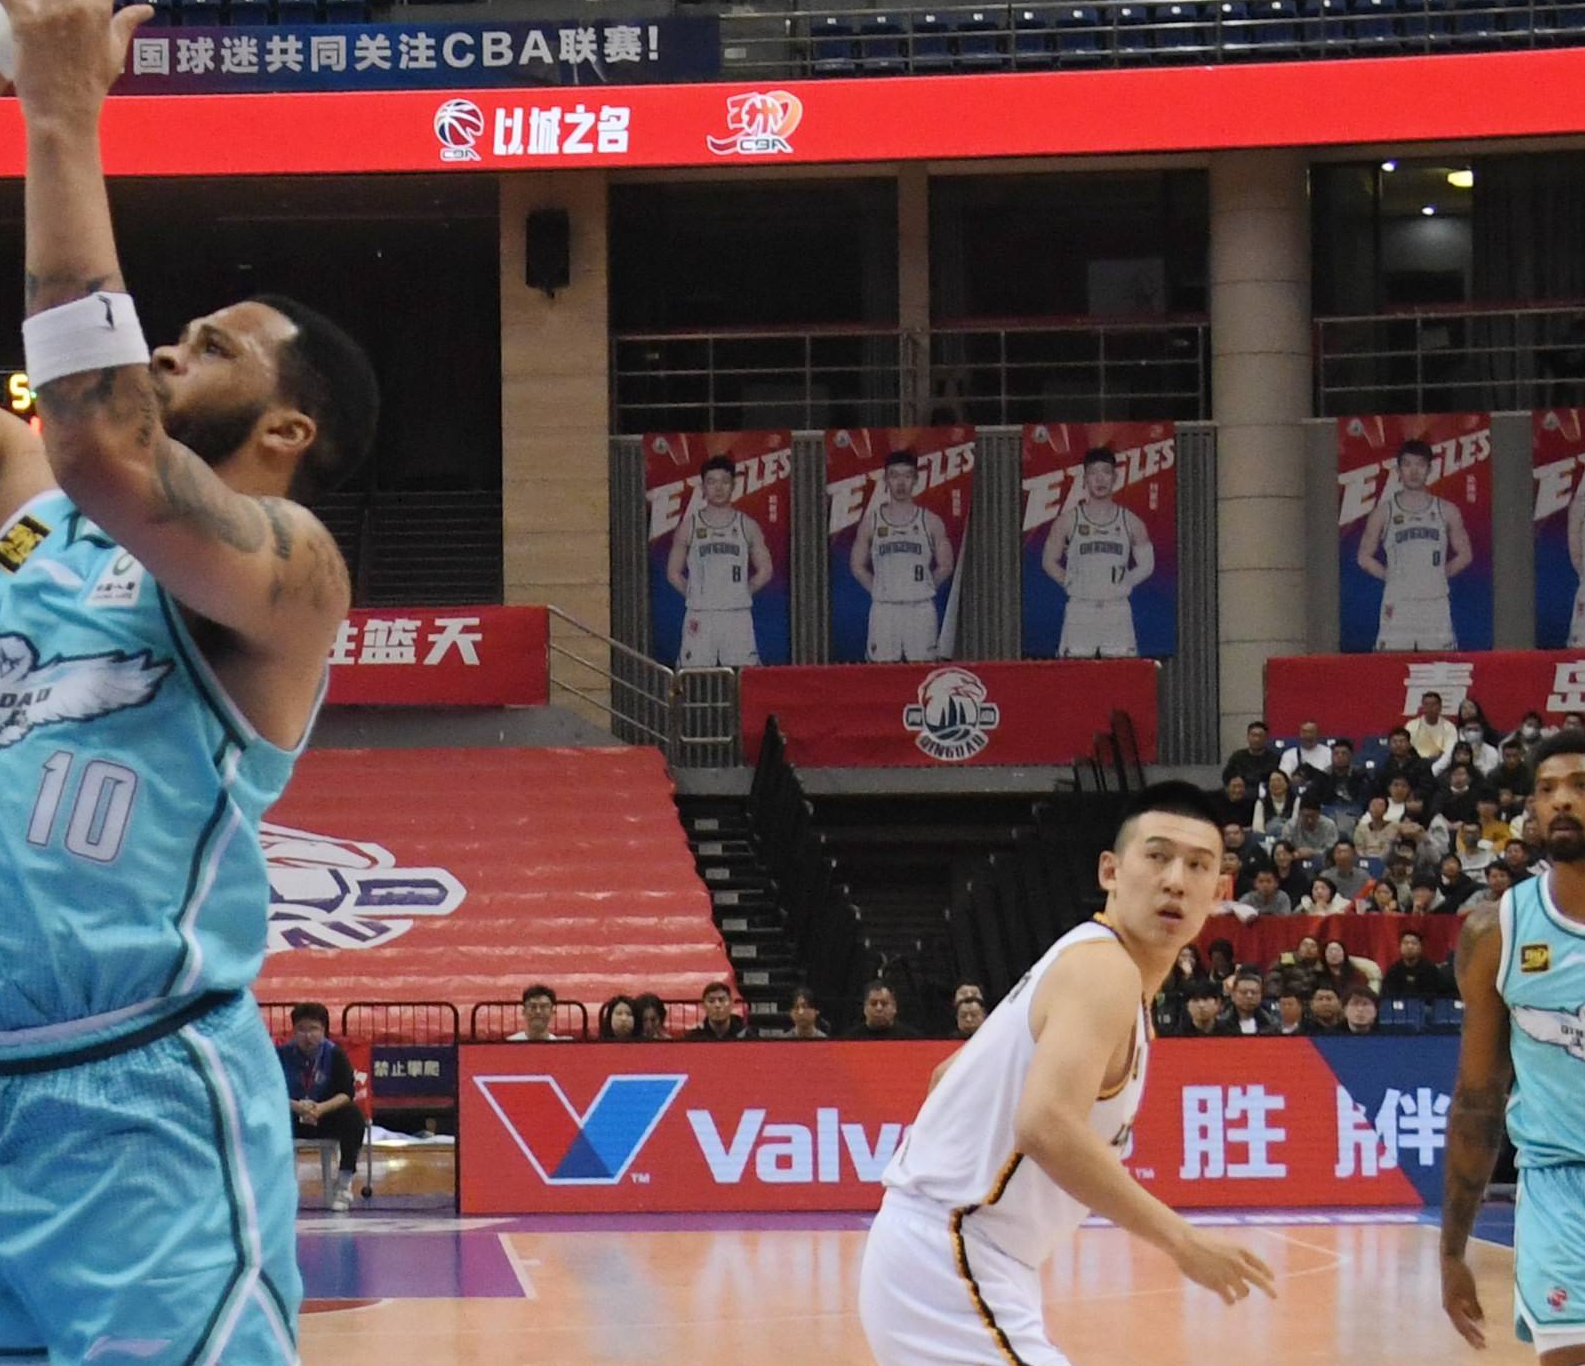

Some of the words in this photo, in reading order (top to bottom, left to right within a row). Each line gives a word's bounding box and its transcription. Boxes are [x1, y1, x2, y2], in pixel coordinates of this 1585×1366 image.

[121, 24, 658, 76] 国球迷共同关注CBA联赛!
[495, 104, 630, 156] 以城之名
[26, 749, 139, 864] 10
[686, 1107, 911, 1184] Valv
